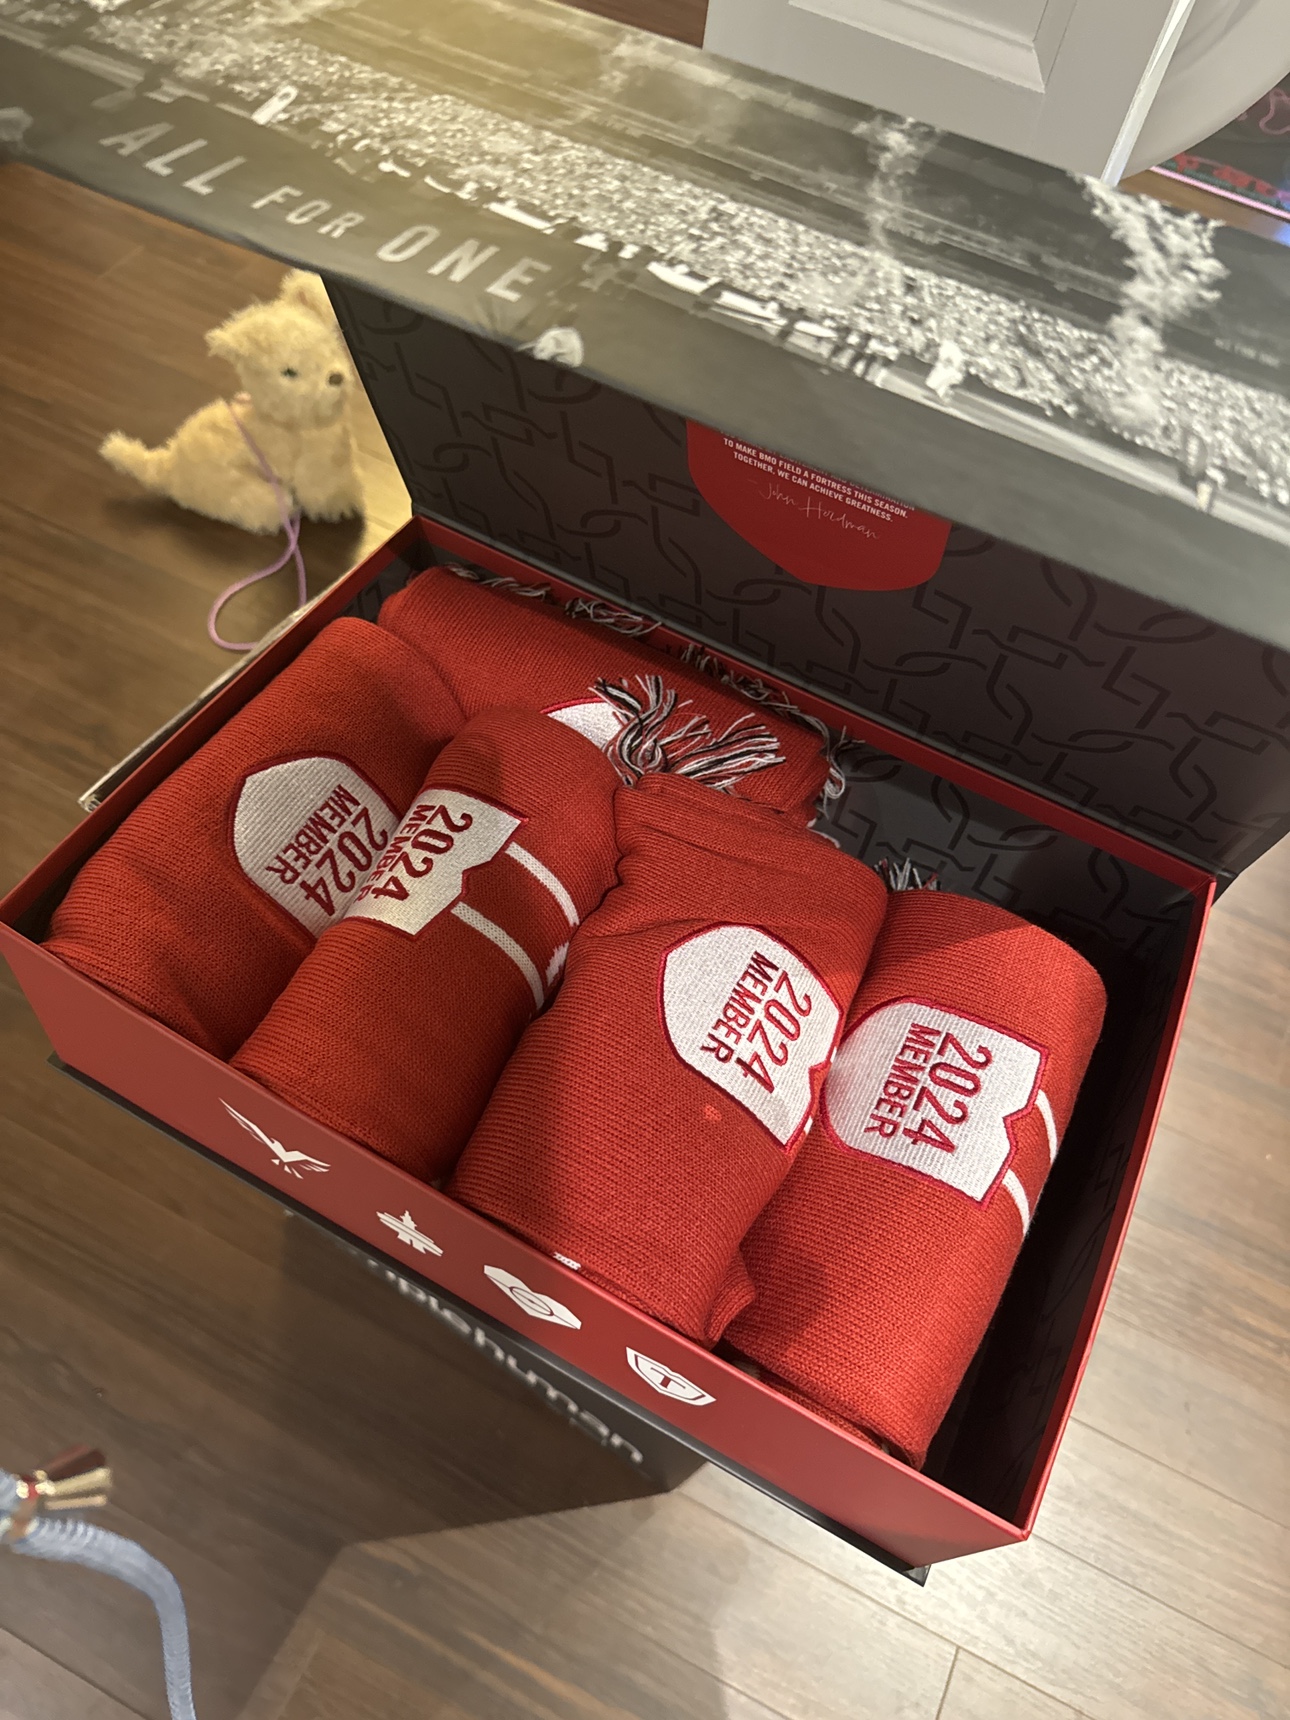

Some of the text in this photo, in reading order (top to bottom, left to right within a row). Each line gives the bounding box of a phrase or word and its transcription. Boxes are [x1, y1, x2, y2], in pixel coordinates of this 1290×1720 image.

[100, 122, 552, 302] ALL FOR ONE
[723, 437, 908, 519] TO MAKE BMO FIELD A FORTRESS THIS SEASON.
[759, 482, 797, 505] John
[777, 468, 790, 480] WE
[791, 475, 808, 487] CAN
[809, 483, 844, 502] ACHIEVE
[845, 497, 893, 522] GREATNESS.
[265, 784, 361, 885] MEMBER
[299, 807, 389, 917] 2024
[354, 804, 437, 901] MEMBER
[371, 804, 473, 902] 2024
[700, 950, 779, 1065] MEMBER
[733, 970, 812, 1093] 2024
[864, 1022, 942, 1139] MEMBER
[902, 1032, 993, 1154] 2024
[370, 1257, 644, 1465] plehuman
